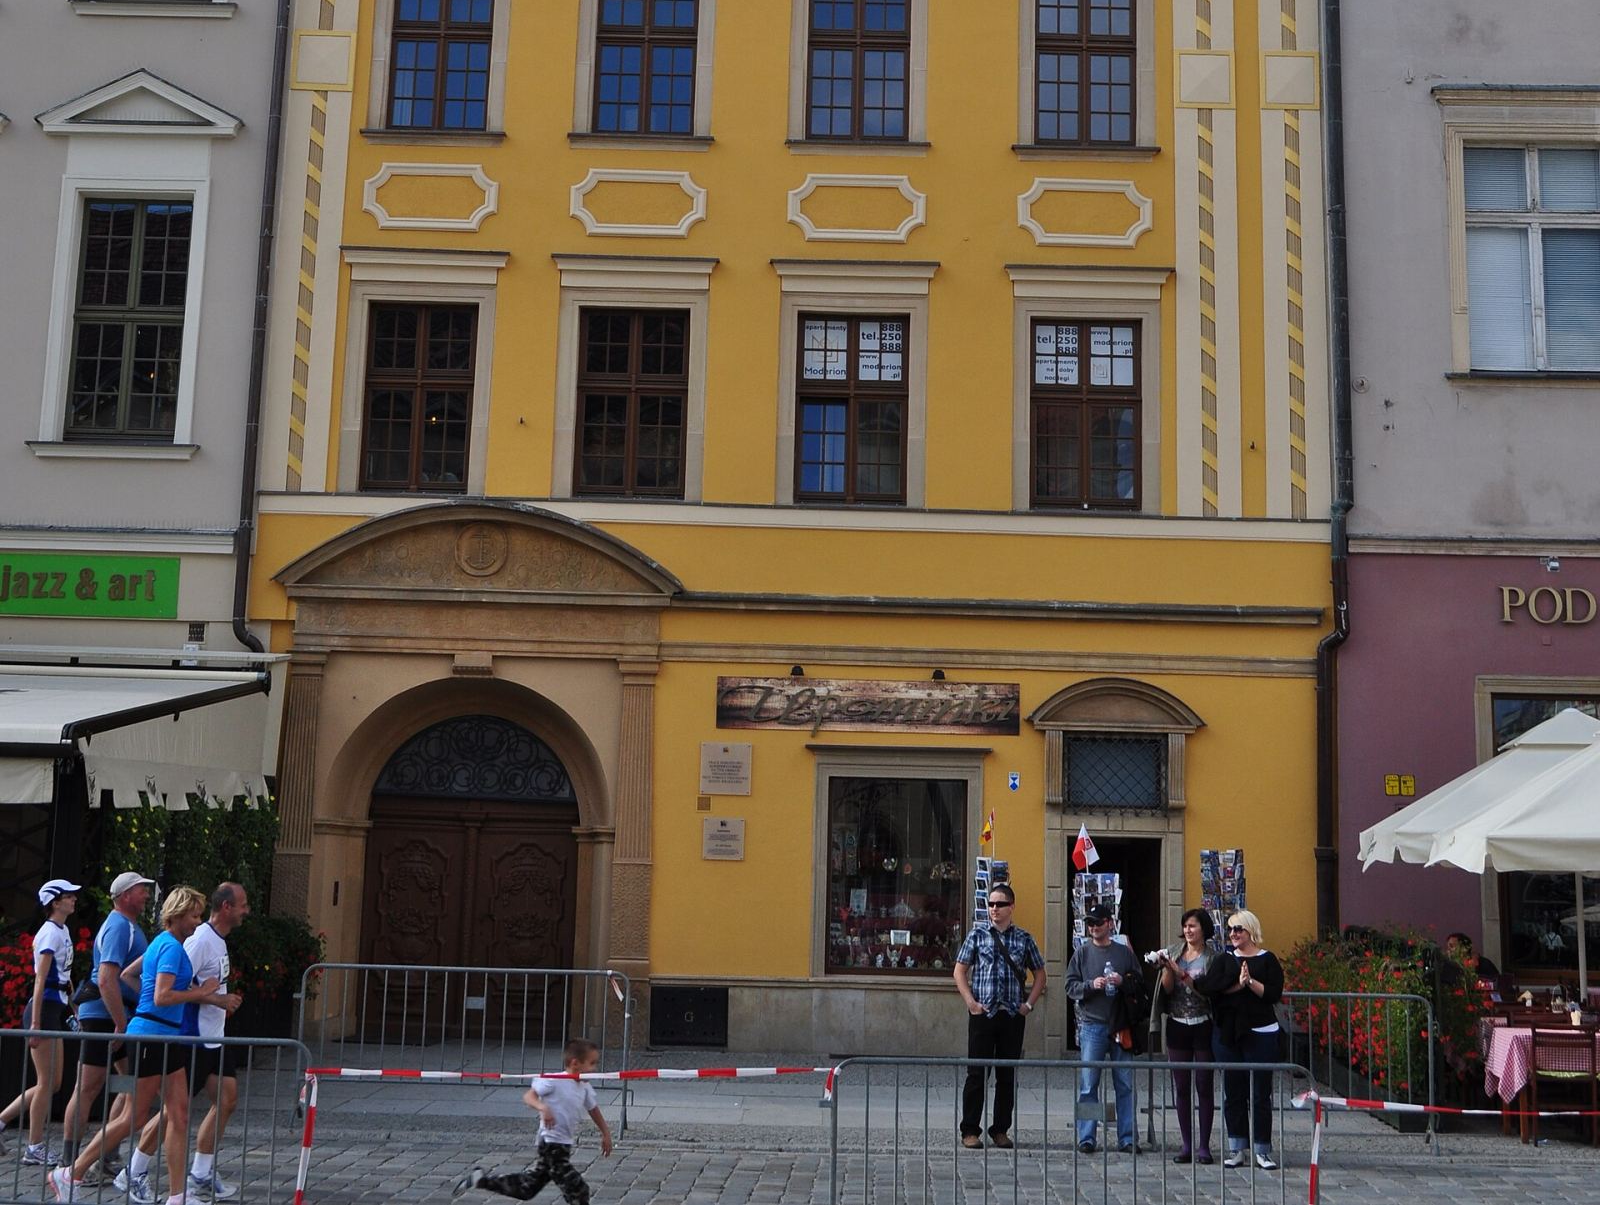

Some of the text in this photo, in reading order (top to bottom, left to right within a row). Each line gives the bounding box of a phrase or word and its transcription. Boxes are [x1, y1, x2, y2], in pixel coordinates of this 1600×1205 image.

[881, 323, 902, 332] 888
[1057, 327, 1078, 336] 888
[861, 331, 902, 341] tel. 250
[1037, 335, 1077, 345] tel. 250
[881, 342, 902, 351] 888
[1057, 346, 1078, 355] 888
[0, 565, 157, 602] jazz & art
[1499, 586, 1597, 625] POD
